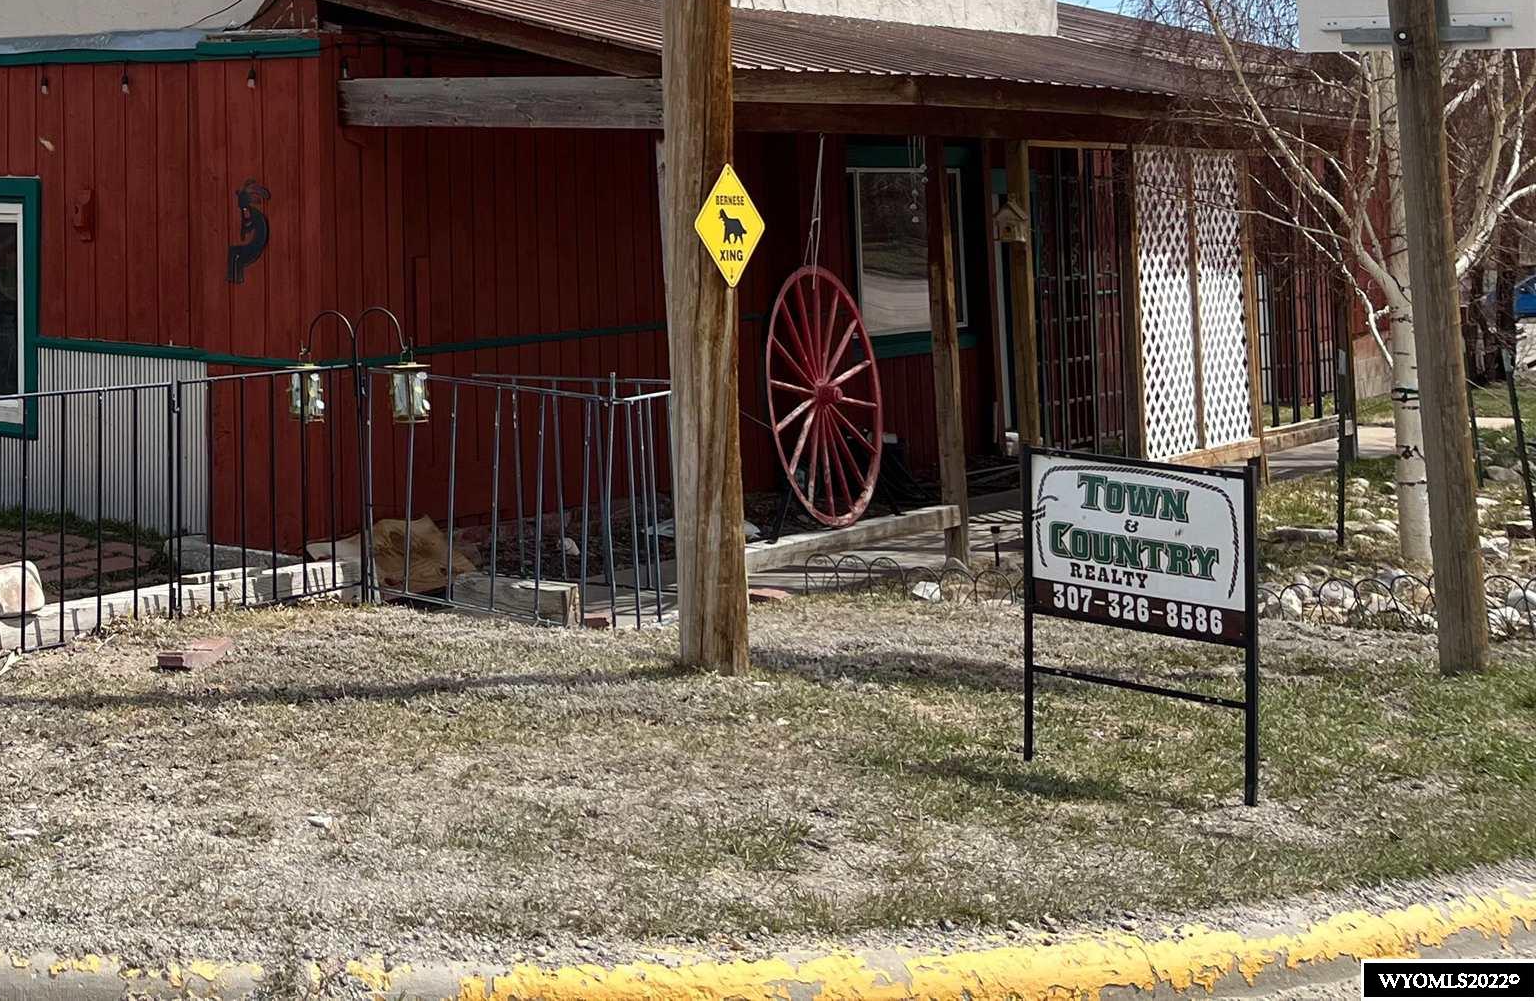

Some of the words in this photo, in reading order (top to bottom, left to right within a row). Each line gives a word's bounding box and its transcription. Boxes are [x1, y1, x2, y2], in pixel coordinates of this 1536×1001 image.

[715, 195, 745, 206] BERNESE
[719, 249, 743, 262] XING
[1077, 472, 1190, 524] TOWN
[1124, 519, 1140, 533] &
[1048, 520, 1219, 581] COUNTRY
[1070, 562, 1149, 589] REALTY
[1052, 583, 1223, 636] 307-326-8586
